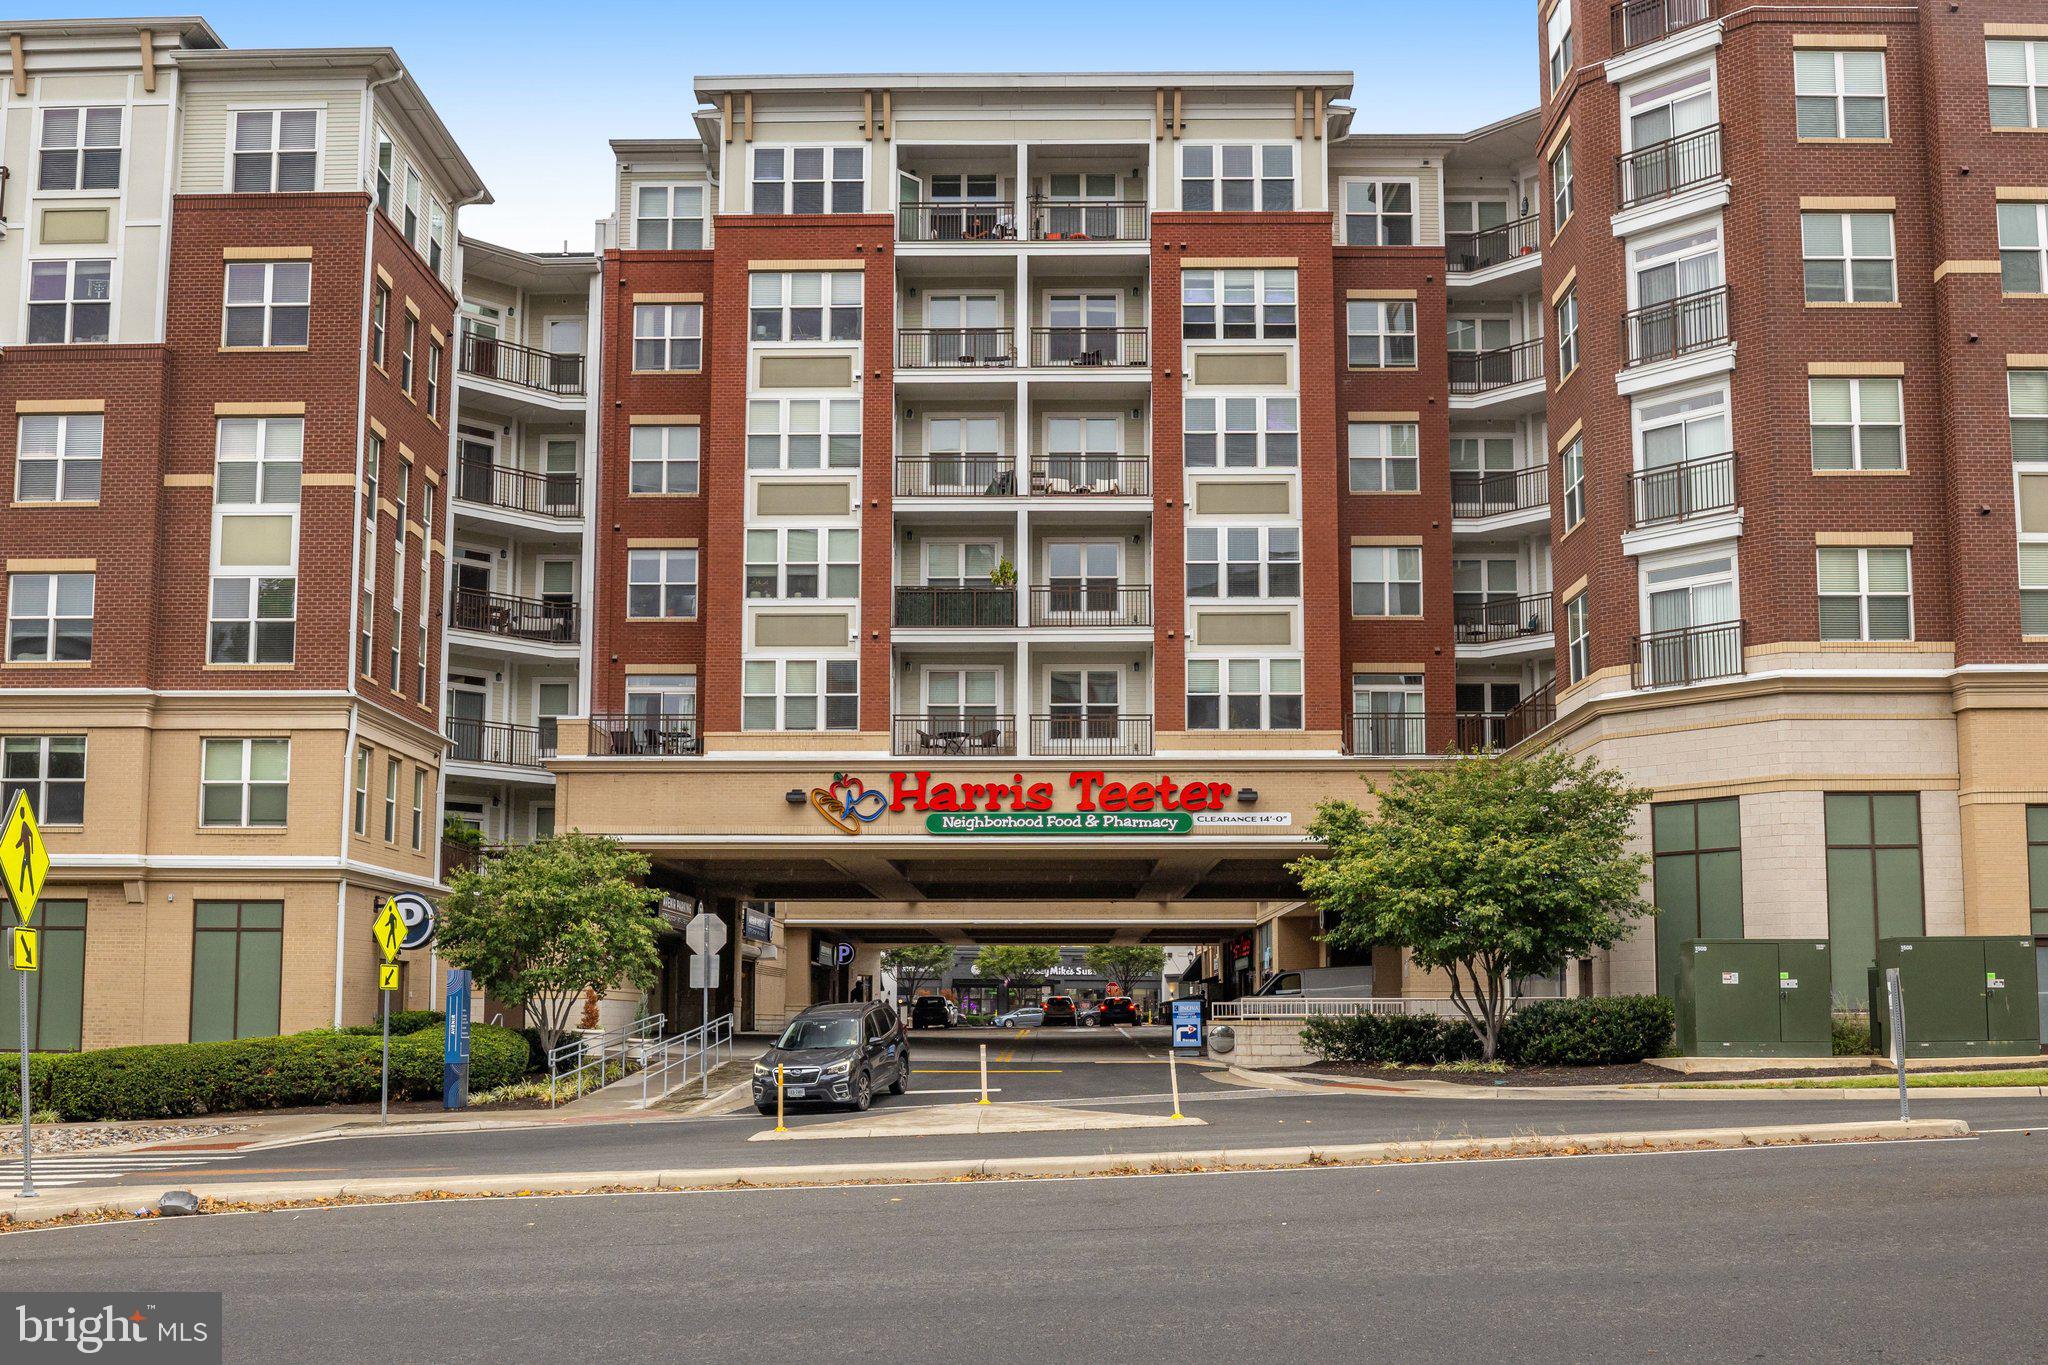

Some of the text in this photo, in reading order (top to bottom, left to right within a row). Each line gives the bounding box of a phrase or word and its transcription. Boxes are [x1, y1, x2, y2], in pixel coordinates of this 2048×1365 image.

[889, 771, 1232, 812] Harris Teeter
[942, 814, 1178, 831] Neighborhood Food & Pharmacy
[1196, 815, 1257, 823] CLEARANCE
[397, 902, 424, 941] P
[838, 945, 851, 962] P
